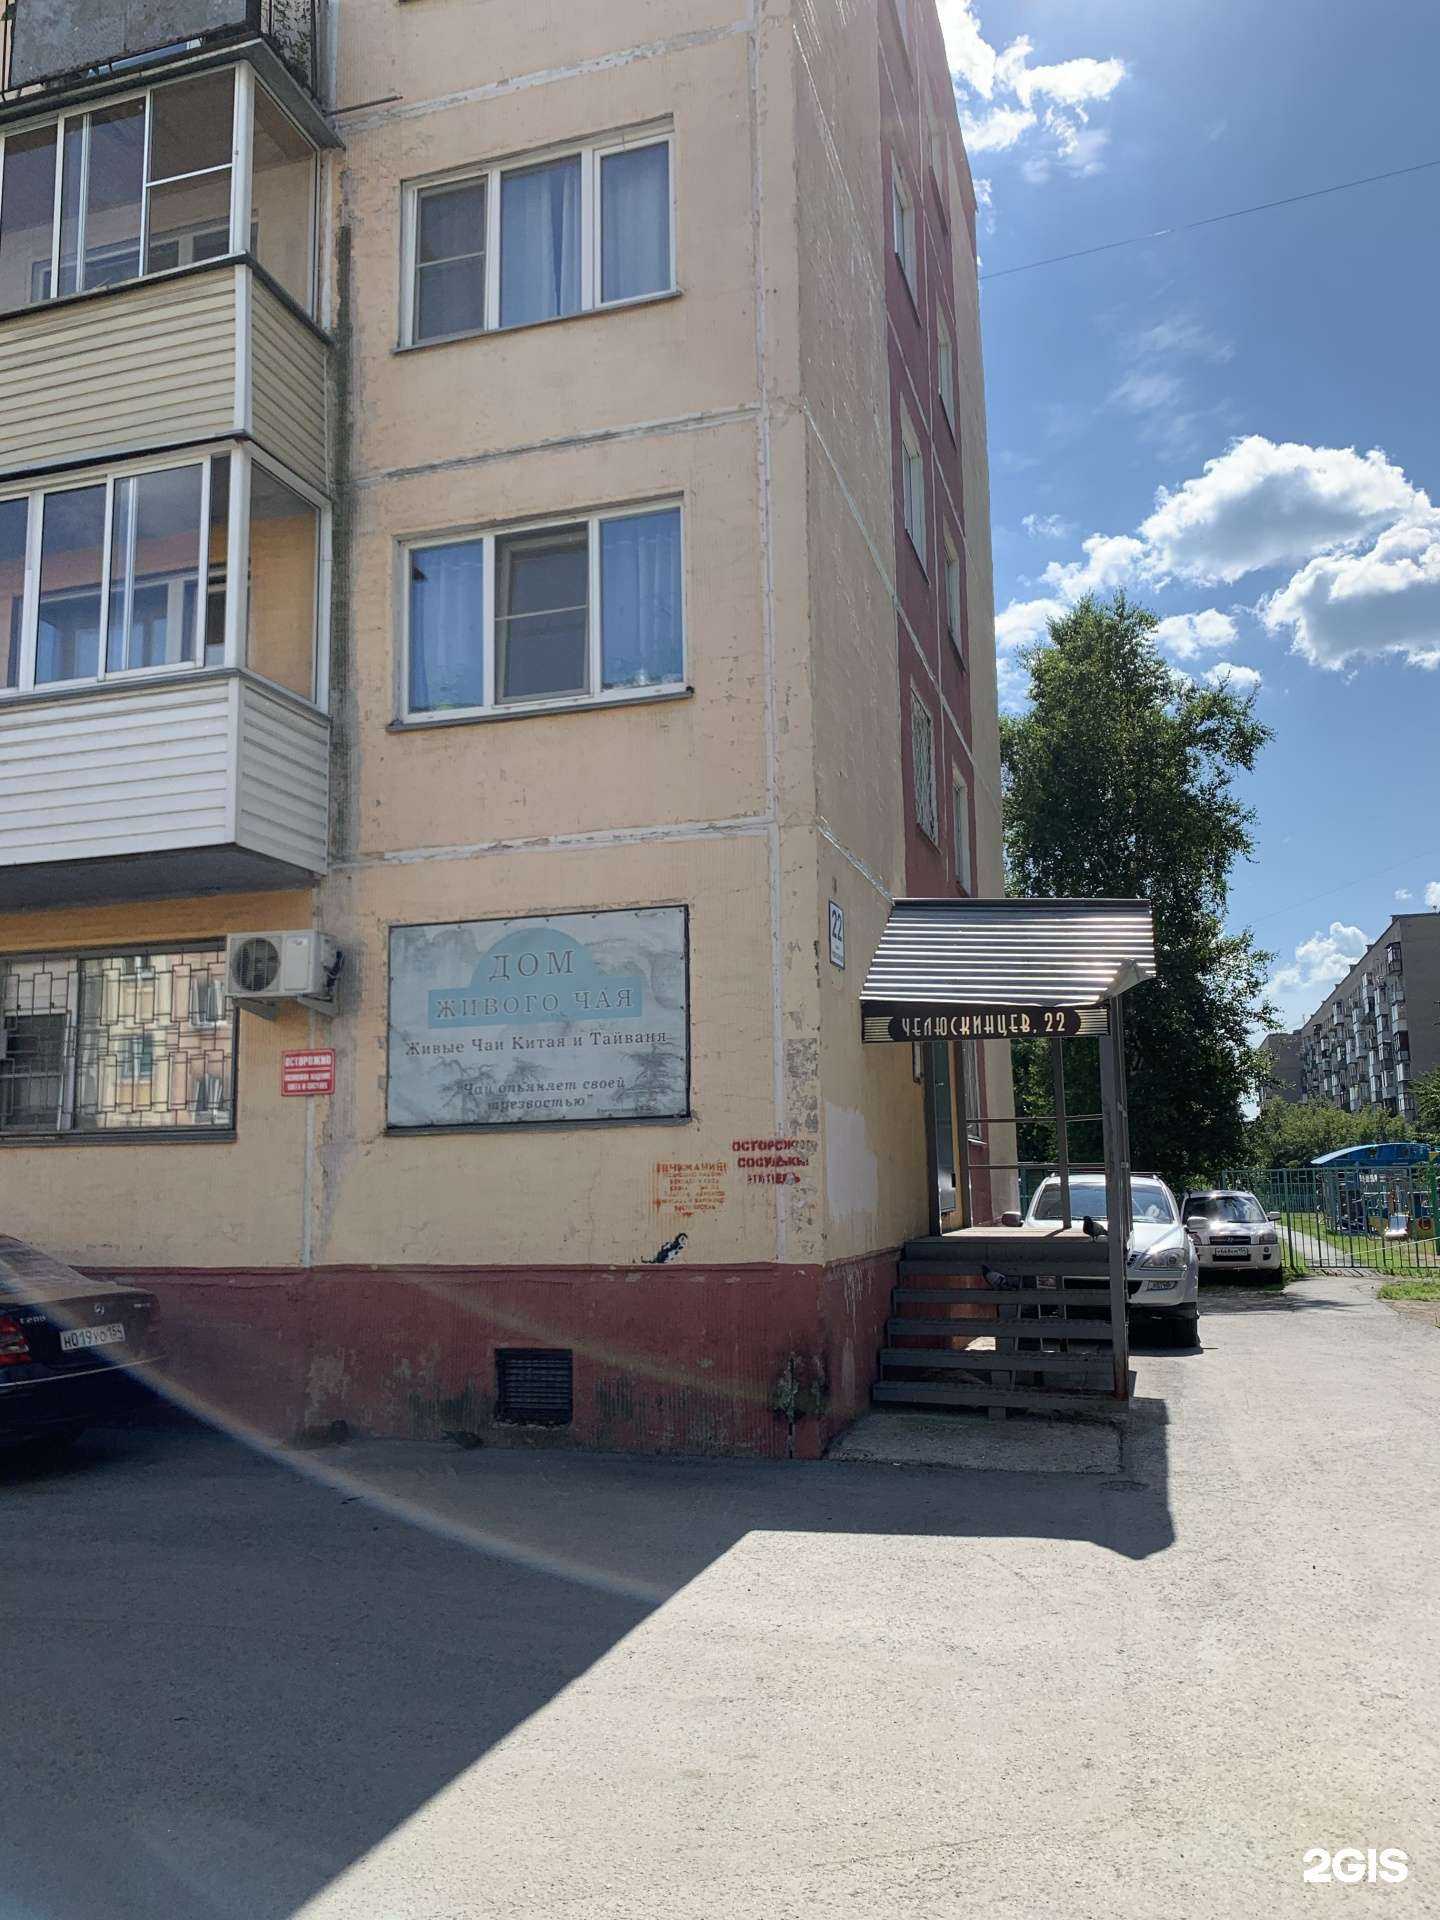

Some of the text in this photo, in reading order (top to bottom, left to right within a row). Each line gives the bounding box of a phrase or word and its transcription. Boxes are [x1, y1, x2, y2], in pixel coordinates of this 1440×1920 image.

[832, 909, 842, 942] 22
[488, 950, 575, 982] ДОМ
[436, 994, 561, 1019] ЖИВОГО
[1044, 1011, 1066, 1032] 22
[405, 1041, 465, 1056] Живые
[512, 1035, 566, 1050] Китая
[573, 1036, 582, 1047] и
[590, 1031, 667, 1046] Тайваня
[582, 1076, 625, 1090] своей
